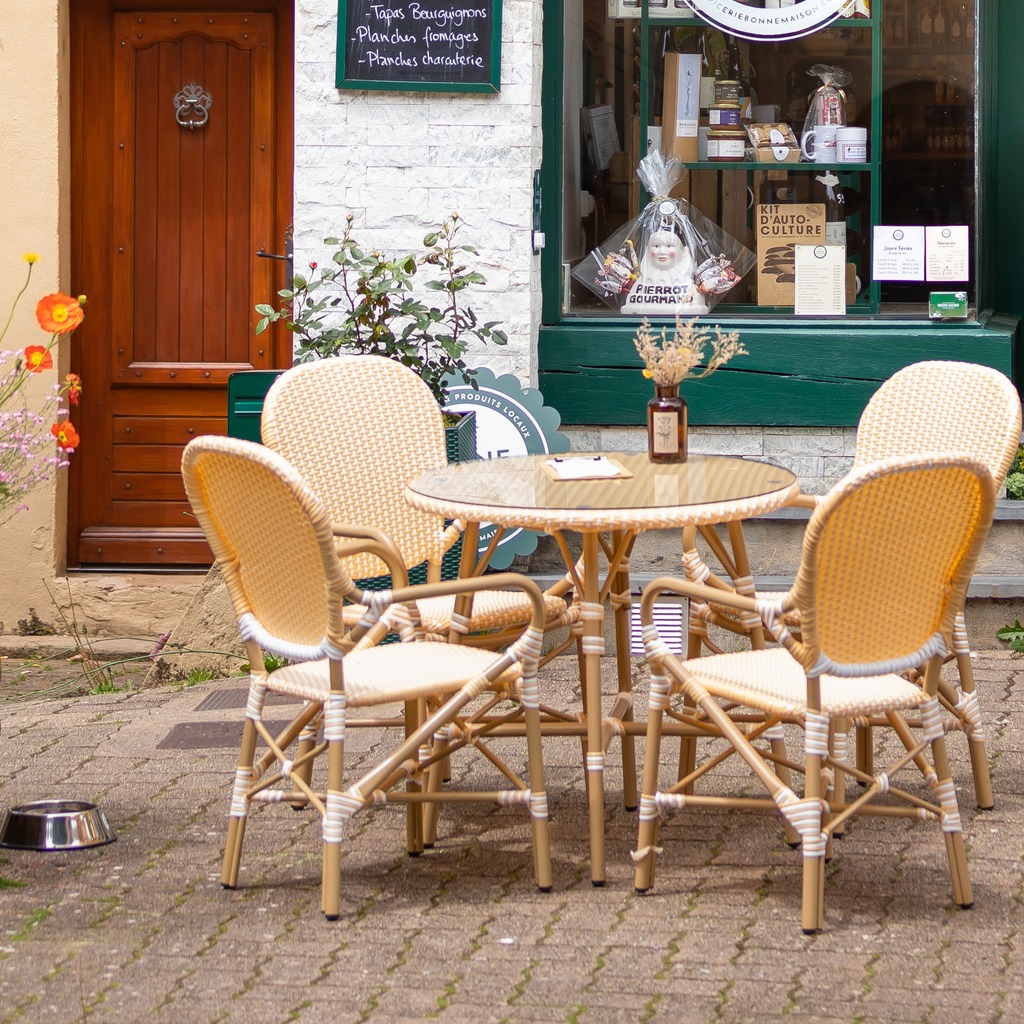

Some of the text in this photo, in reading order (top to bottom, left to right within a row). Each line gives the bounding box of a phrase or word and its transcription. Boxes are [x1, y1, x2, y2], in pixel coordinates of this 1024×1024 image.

[422, 26, 479, 49] fromages
[422, 50, 485, 68] charcuterie
[760, 205, 780, 214] KIT
[760, 215, 811, 225] D'AUTO-
[760, 225, 822, 235] CULTURE
[635, 284, 688, 295] PIERROT
[629, 295, 694, 304] GOURMAND
[454, 392, 502, 409] PRODUITS
[502, 405, 531, 439] LOCAUX
